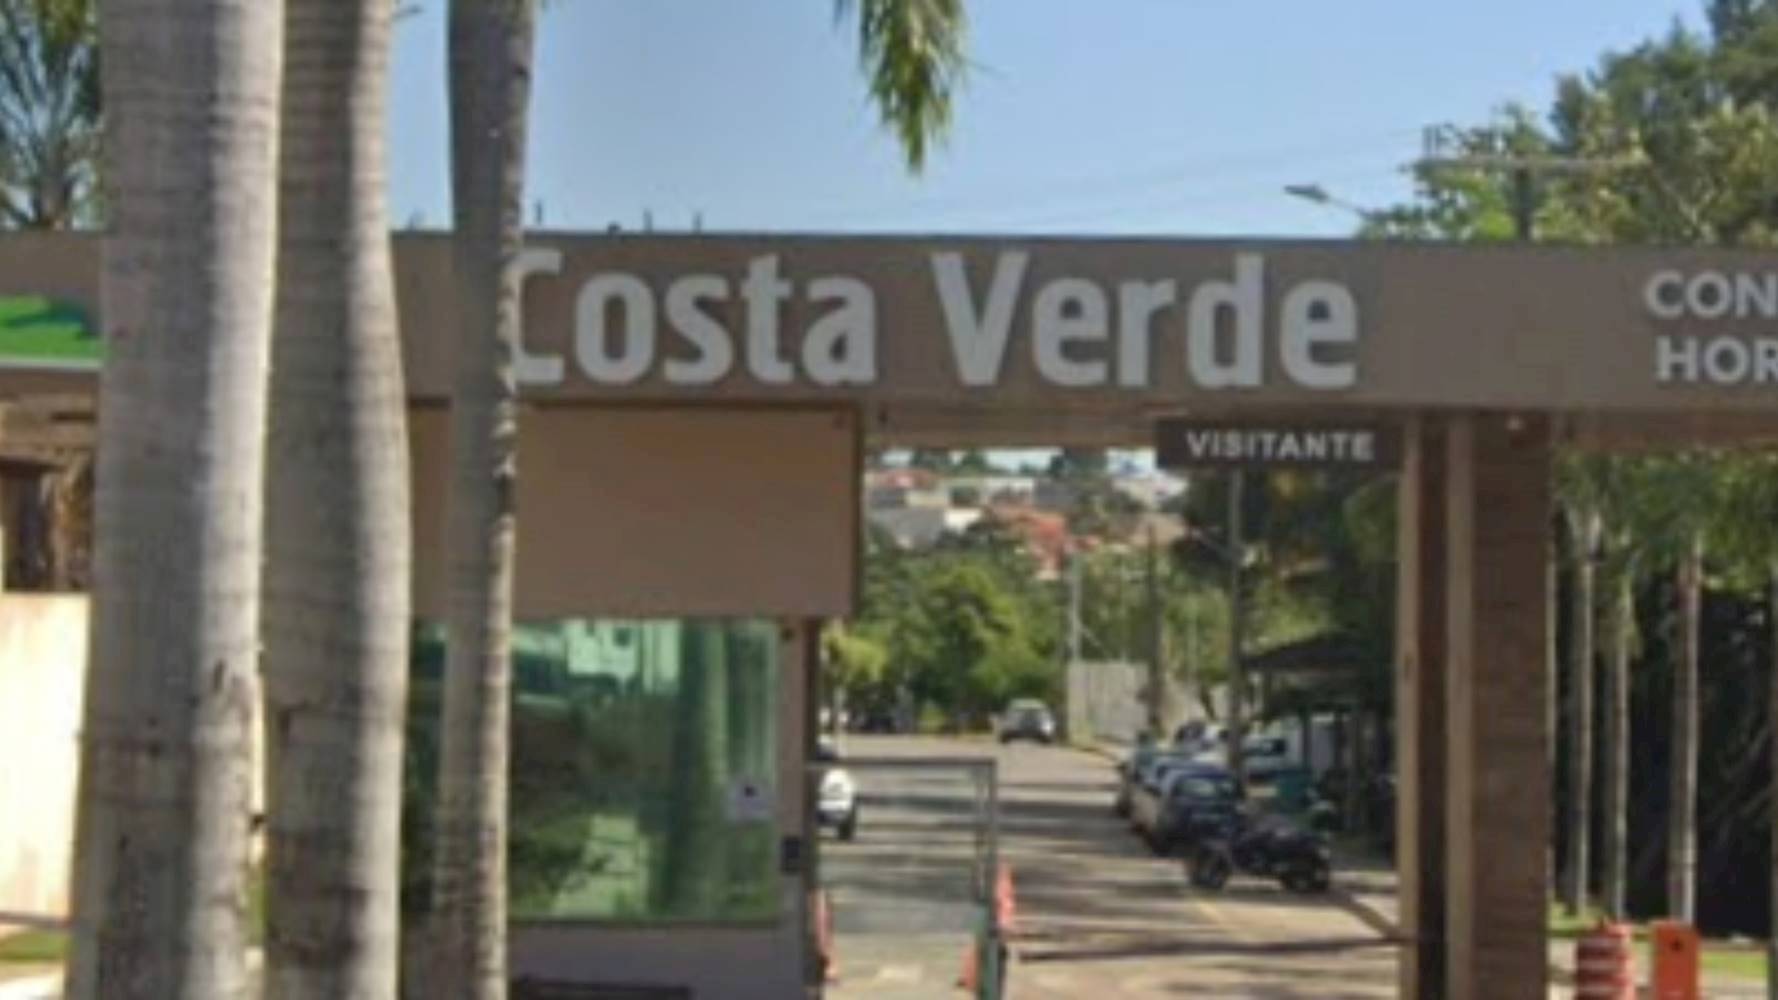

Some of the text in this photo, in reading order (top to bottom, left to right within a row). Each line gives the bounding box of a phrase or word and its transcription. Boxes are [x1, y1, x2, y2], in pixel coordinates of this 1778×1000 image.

[1645, 270, 1778, 318] CON
[511, 249, 1357, 388] Costa Verde
[1185, 430, 1376, 462] VISITANTE
